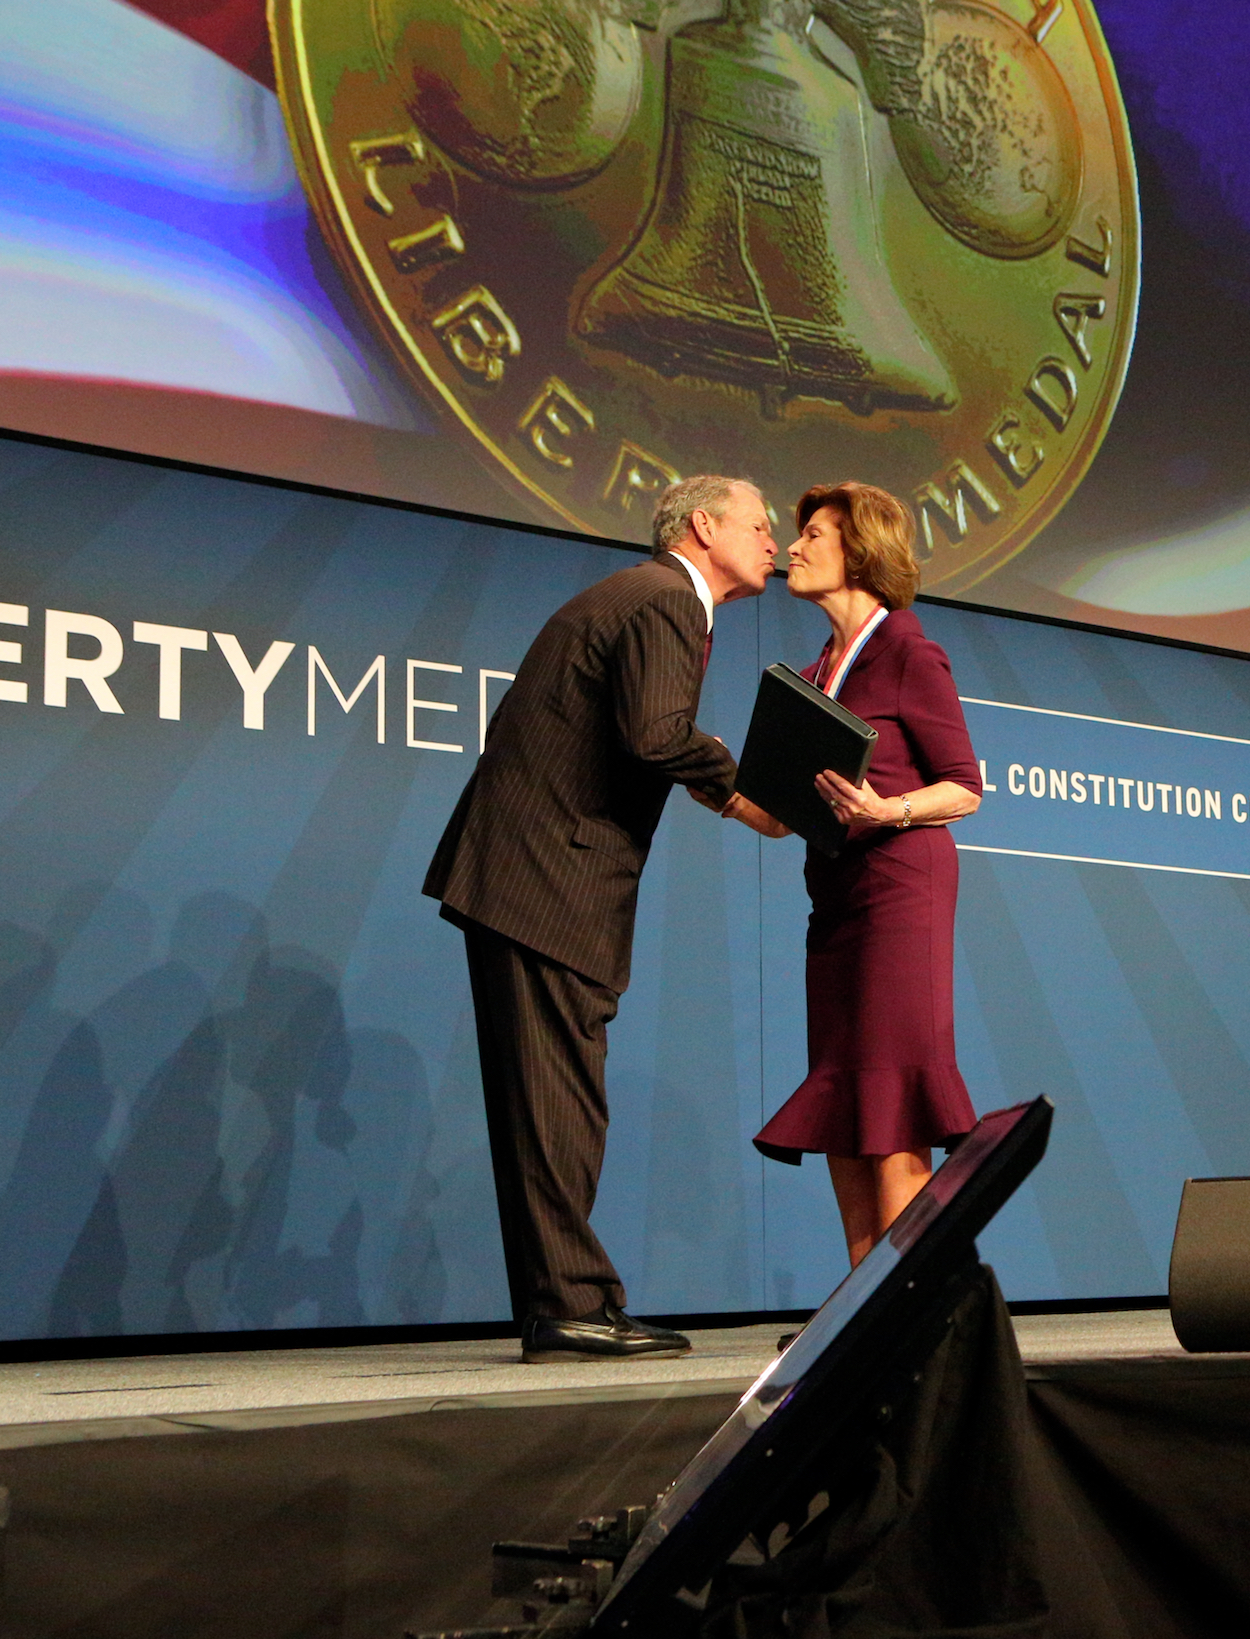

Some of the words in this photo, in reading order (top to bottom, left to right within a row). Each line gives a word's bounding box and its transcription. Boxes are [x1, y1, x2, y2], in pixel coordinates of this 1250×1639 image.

[349, 130, 692, 512] LIBER
[911, 214, 1113, 564] MEDAL
[1007, 763, 1222, 820] CONSTITUTION
